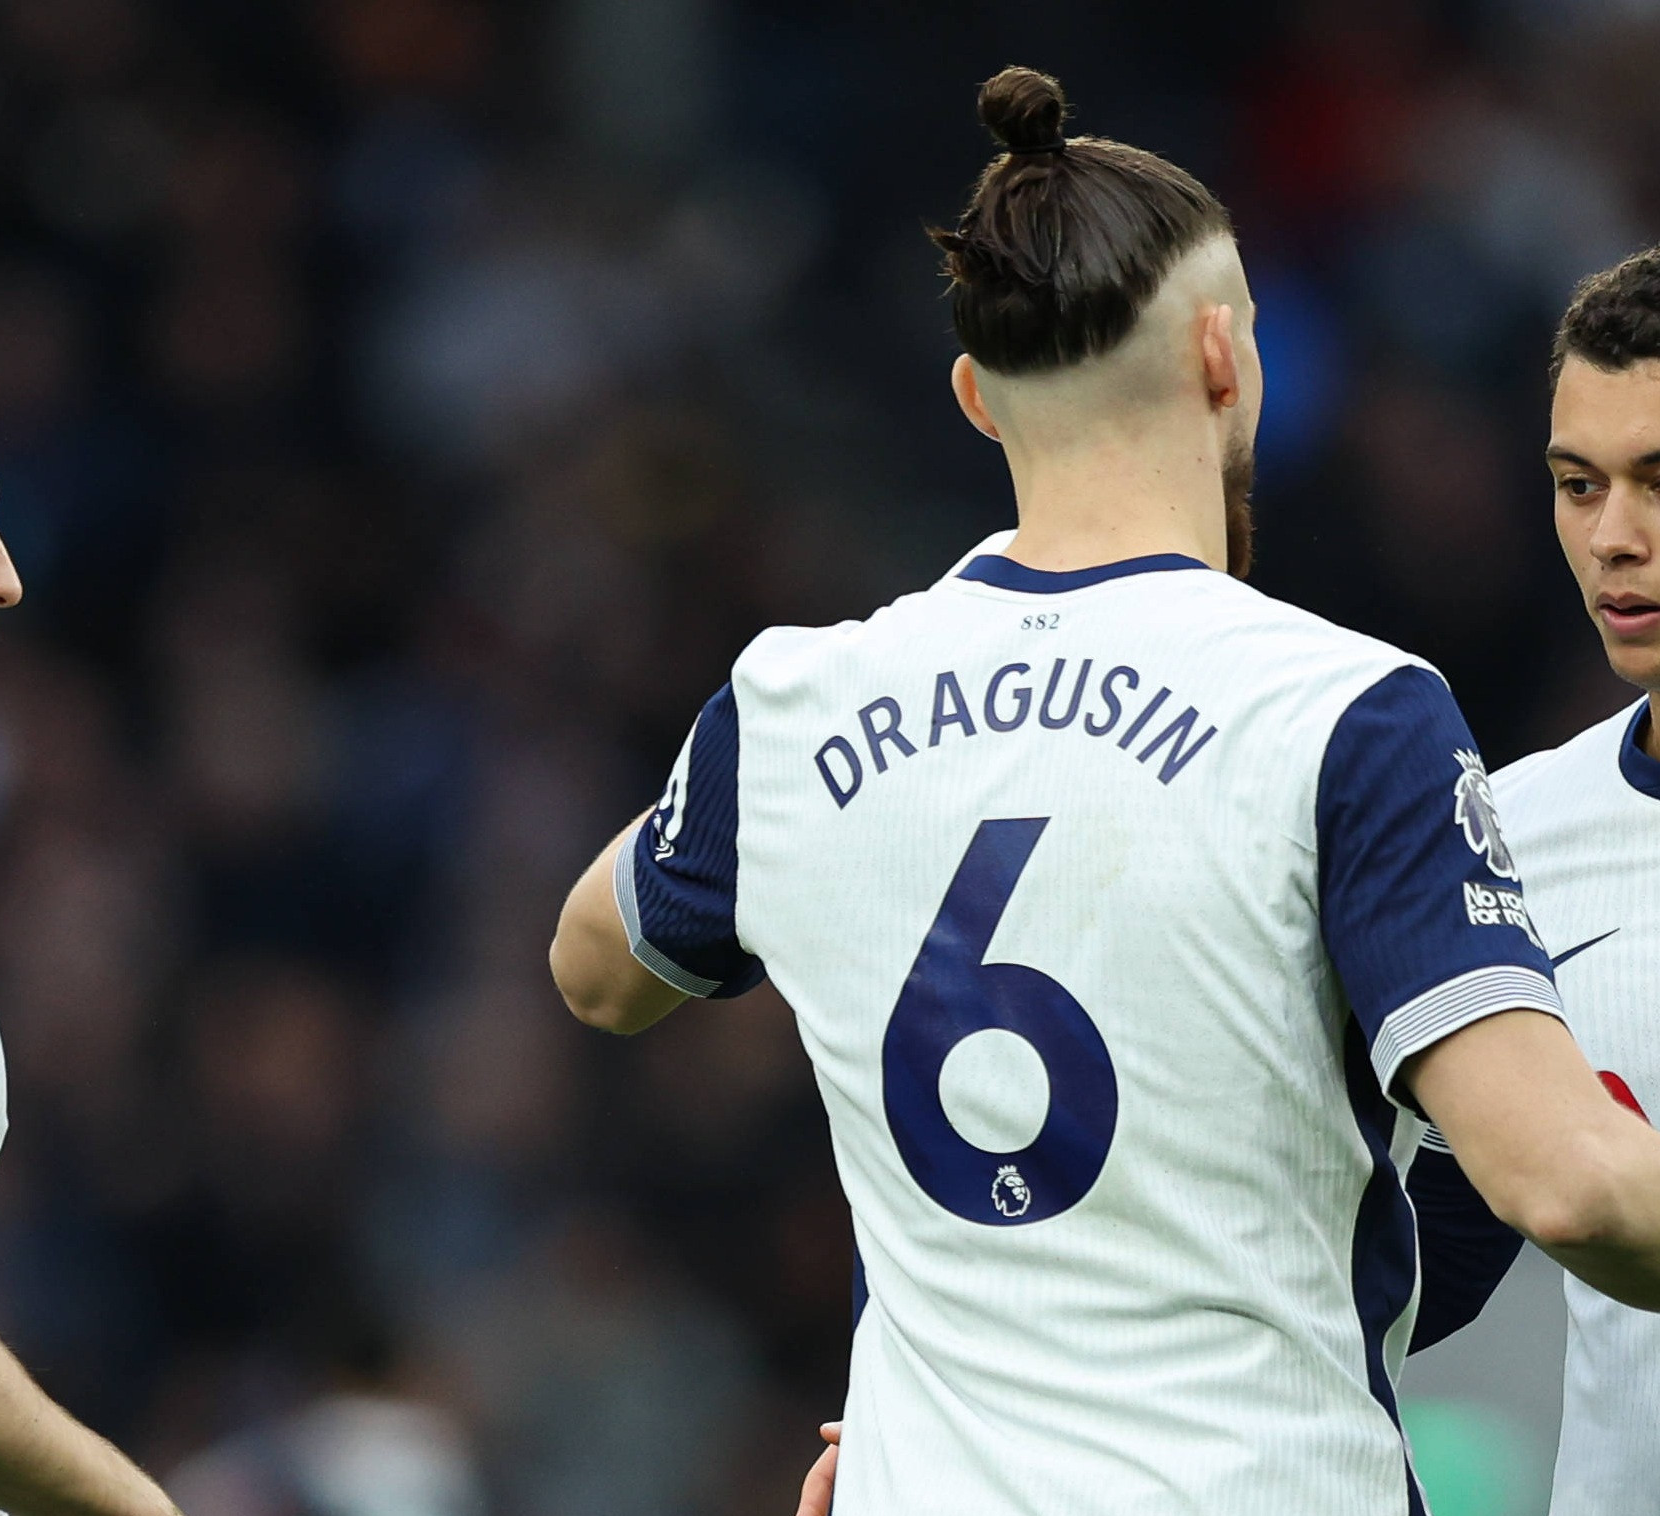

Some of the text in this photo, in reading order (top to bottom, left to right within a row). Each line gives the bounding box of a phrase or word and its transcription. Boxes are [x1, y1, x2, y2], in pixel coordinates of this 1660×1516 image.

[1020, 613, 1060, 630] 882
[813, 658, 1218, 810] DRAGUSIN
[1463, 882, 1497, 909] No
[1467, 904, 1501, 925] for
[882, 816, 1118, 1227] 6
